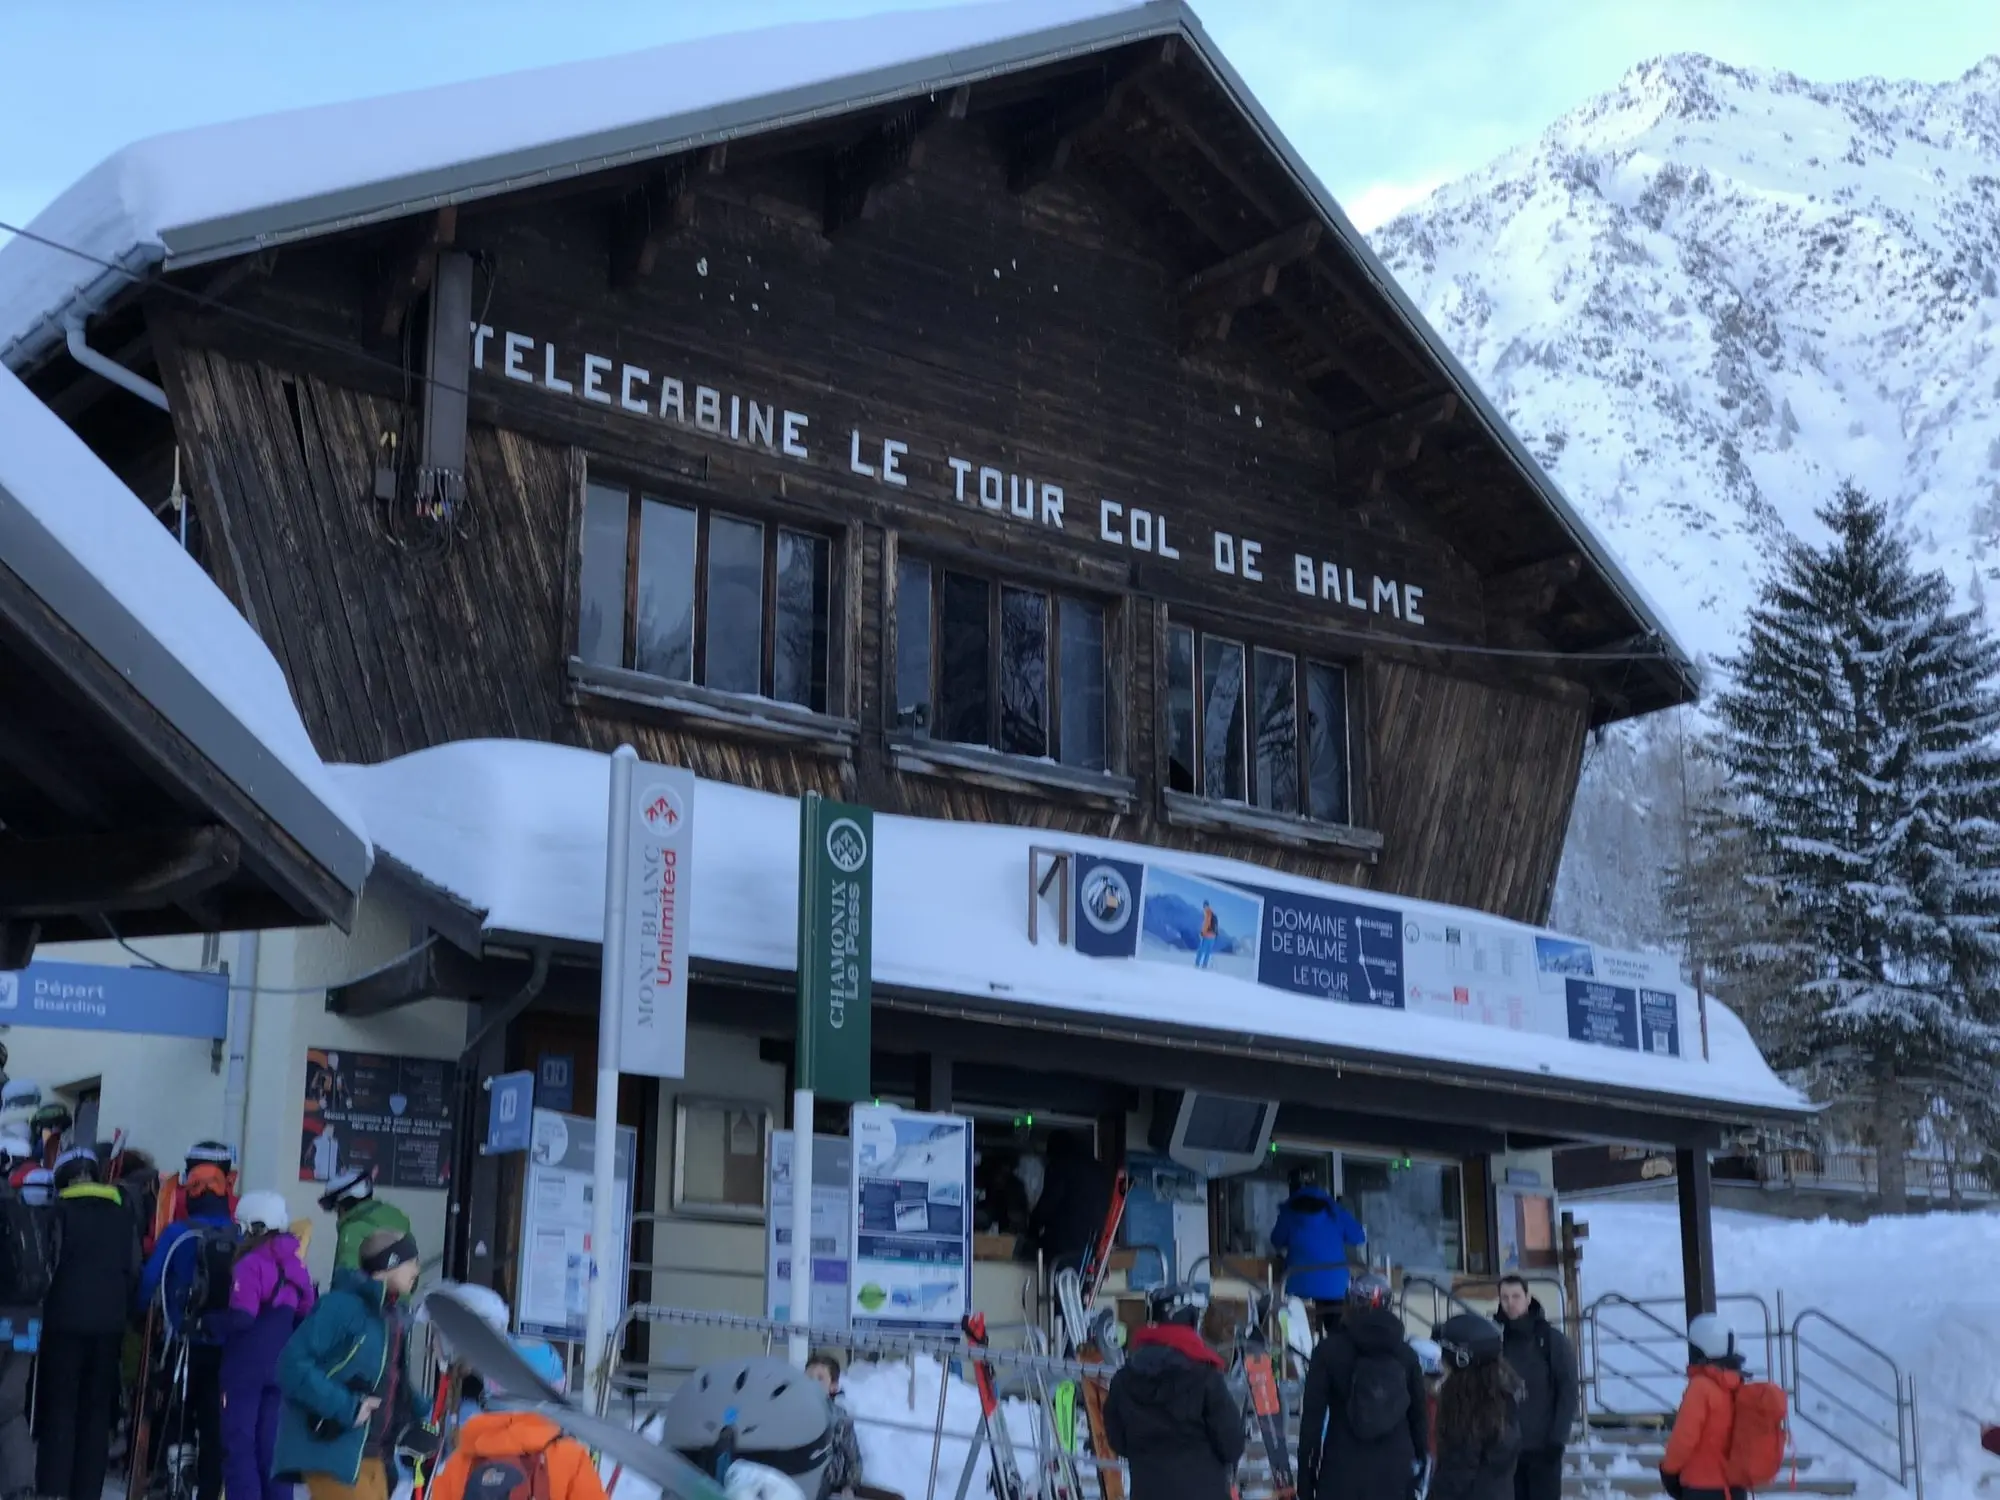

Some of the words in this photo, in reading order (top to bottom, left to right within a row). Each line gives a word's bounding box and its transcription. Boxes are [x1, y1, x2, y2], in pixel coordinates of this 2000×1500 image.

[470, 322, 809, 459] TELECABINE
[850, 429, 908, 487] LE
[948, 456, 1065, 528] TOUR
[1100, 499, 1180, 560] COL
[1214, 531, 1263, 582] DE
[1294, 552, 1425, 625] BALME
[642, 845, 661, 939] BLANC
[656, 848, 677, 986] Unlimited
[847, 883, 861, 954] Pass
[1271, 930, 1294, 954] DE
[1297, 935, 1348, 964] BALME
[1272, 905, 1348, 940] DOMAINE
[829, 880, 846, 1029] CHAMONIX
[1294, 965, 1309, 985] LE
[1311, 967, 1349, 991] TOUR
[34, 978, 103, 999] Départ
[34, 996, 106, 1016] Boarding
[636, 944, 656, 1028] MONT
[845, 964, 860, 1000] Le
